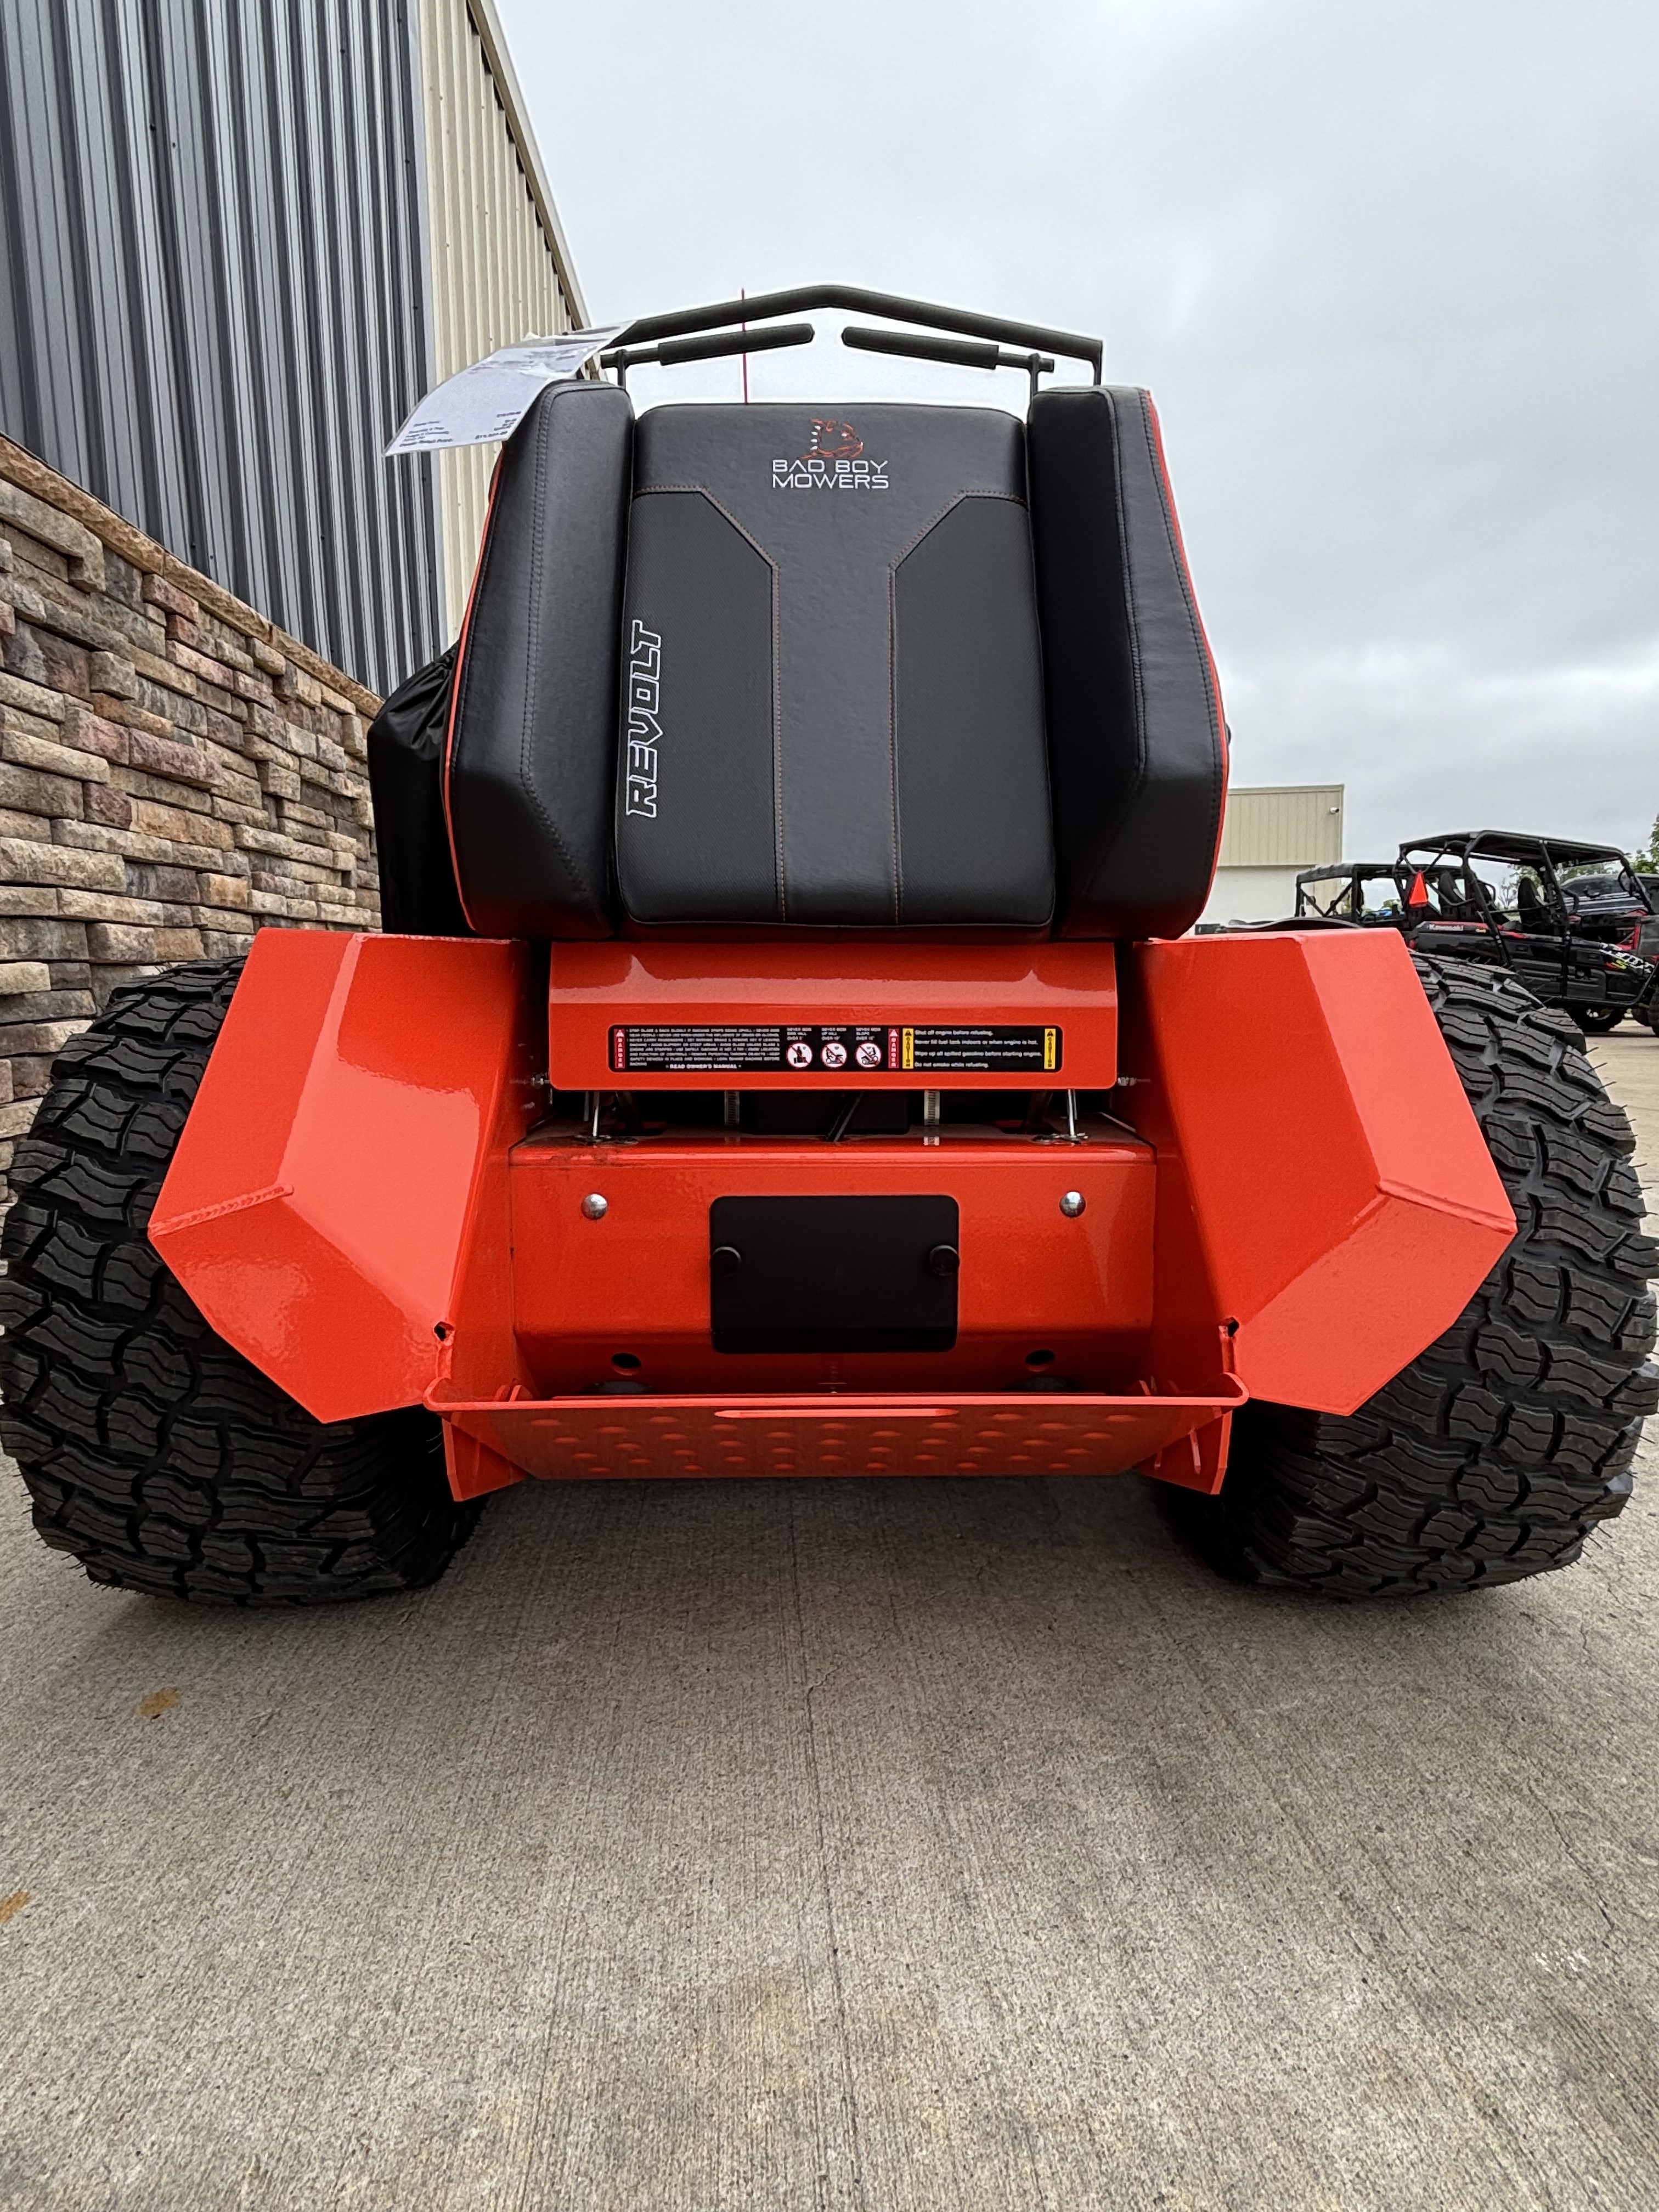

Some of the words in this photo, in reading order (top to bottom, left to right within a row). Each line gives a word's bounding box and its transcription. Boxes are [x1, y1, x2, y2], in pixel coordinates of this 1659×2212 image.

[772, 460, 825, 472] BAD
[836, 460, 888, 473] BOY
[772, 473, 889, 489] MOWERS
[626, 619, 663, 818] REVOLT
